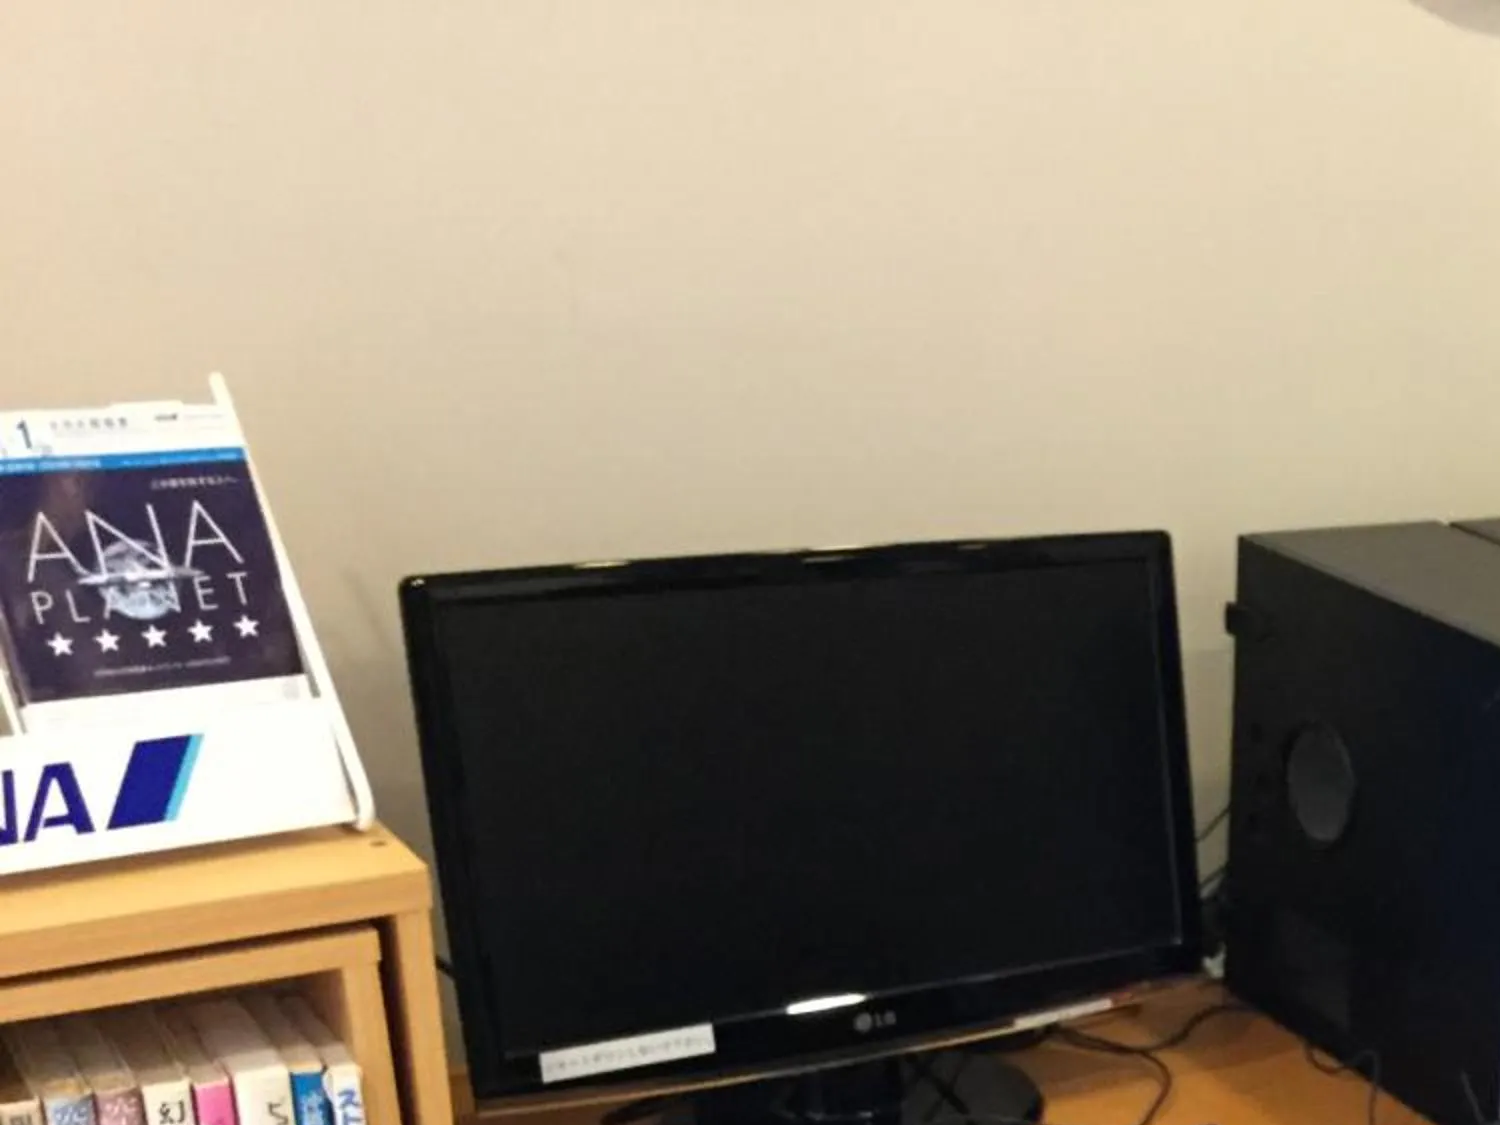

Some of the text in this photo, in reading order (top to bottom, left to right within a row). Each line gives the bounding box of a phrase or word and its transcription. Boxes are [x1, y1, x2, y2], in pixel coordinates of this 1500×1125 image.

[17, 417, 32, 449] 1
[27, 500, 246, 583] ANA
[31, 571, 252, 626] PLANET
